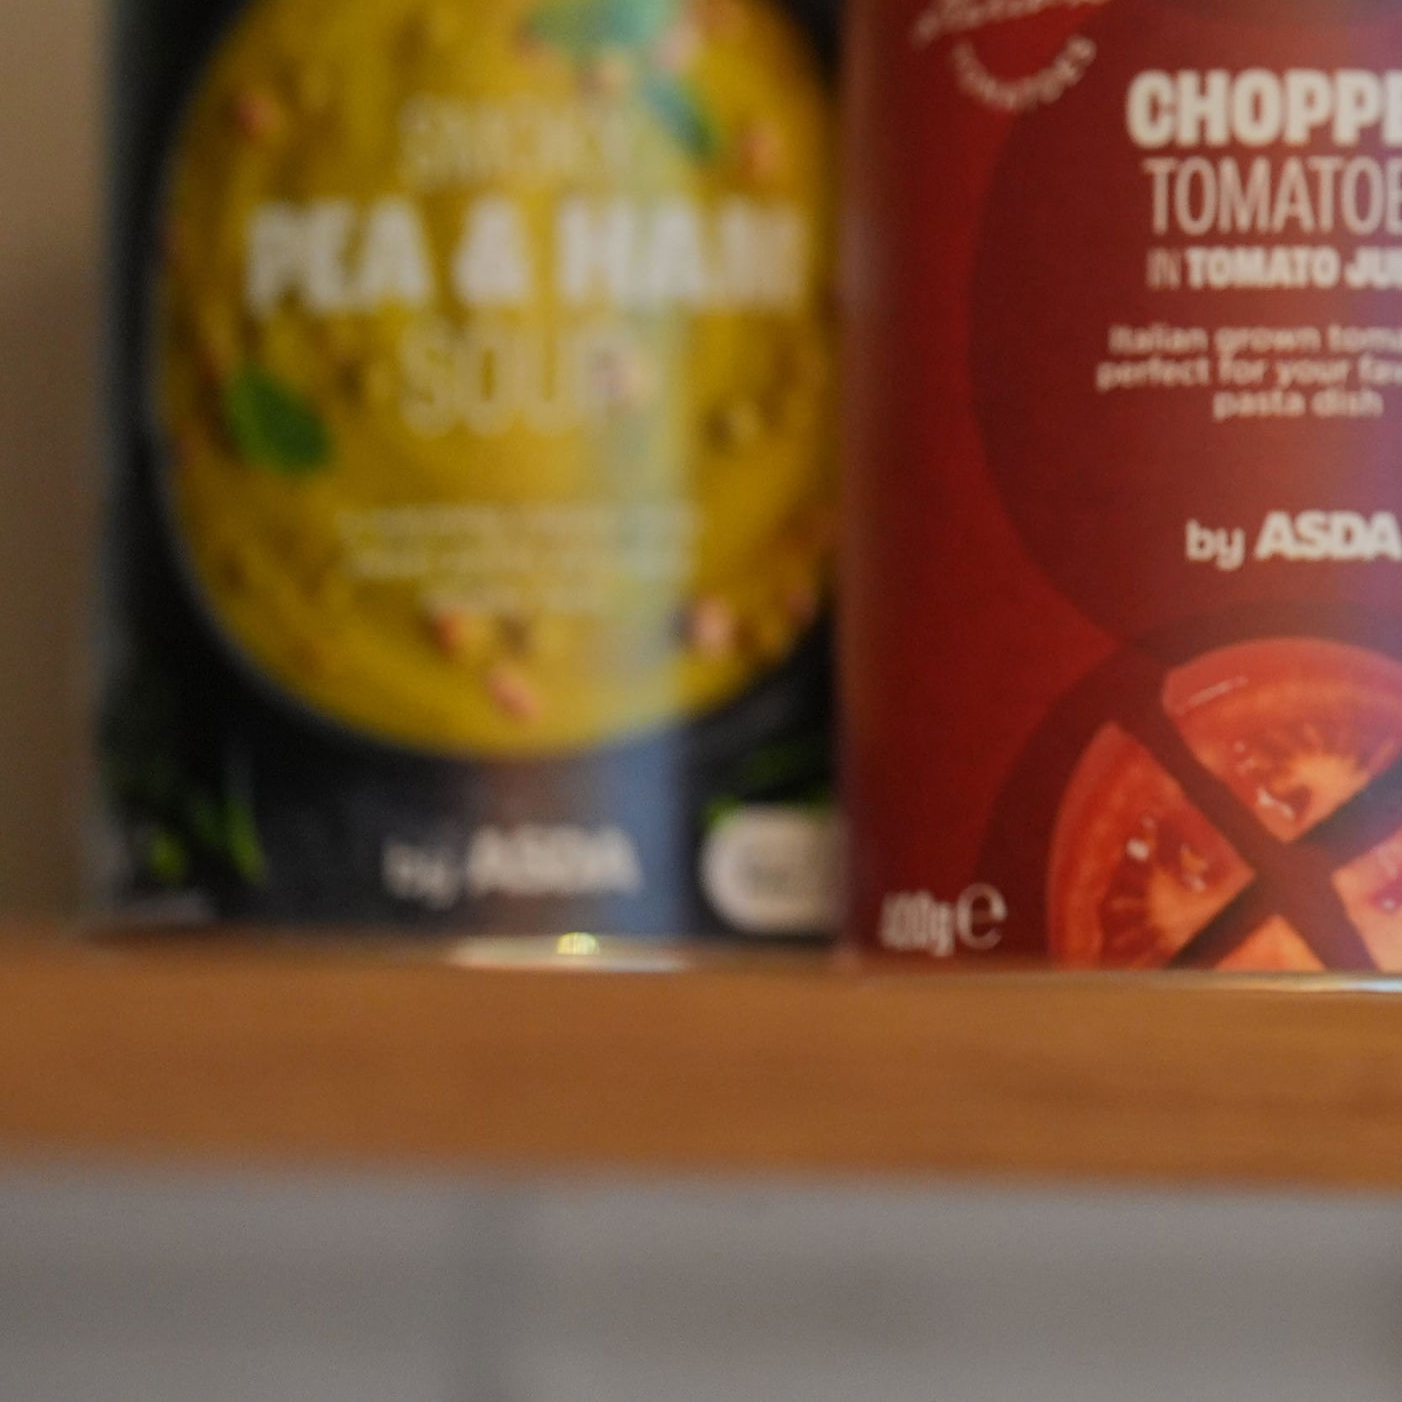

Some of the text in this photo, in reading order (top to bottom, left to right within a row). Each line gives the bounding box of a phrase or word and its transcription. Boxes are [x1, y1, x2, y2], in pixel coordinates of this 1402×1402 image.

[1146, 248, 1181, 290] IN
[1184, 246, 1340, 290] TOMATO
[1108, 324, 1208, 353] Italian
[1214, 327, 1320, 362] grown
[1096, 357, 1209, 392] perfect
[1218, 354, 1266, 384] for
[1275, 360, 1350, 389] your
[1213, 388, 1384, 421] pasta dish
[1185, 519, 1245, 570] by
